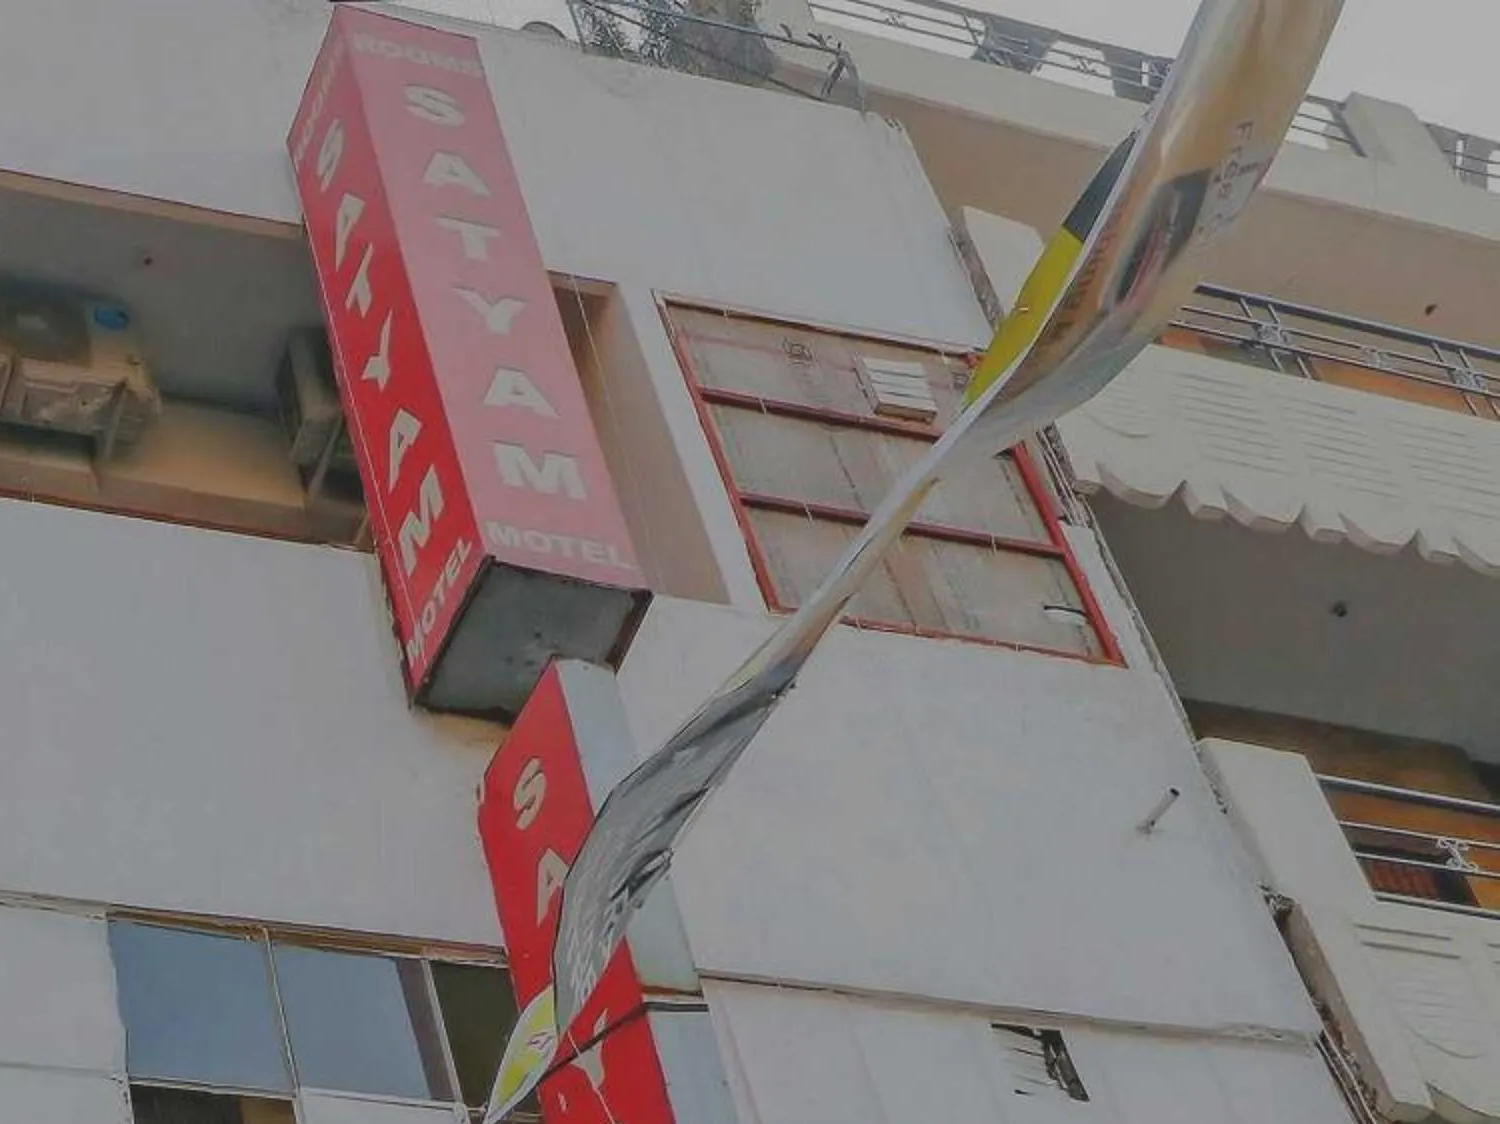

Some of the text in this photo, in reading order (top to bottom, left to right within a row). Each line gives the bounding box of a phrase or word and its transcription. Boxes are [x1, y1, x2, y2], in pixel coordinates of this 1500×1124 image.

[315, 118, 444, 575] SATYAM
[403, 83, 588, 500] SATYAM
[405, 536, 472, 666] MOTEL
[486, 519, 640, 571] MOTEL
